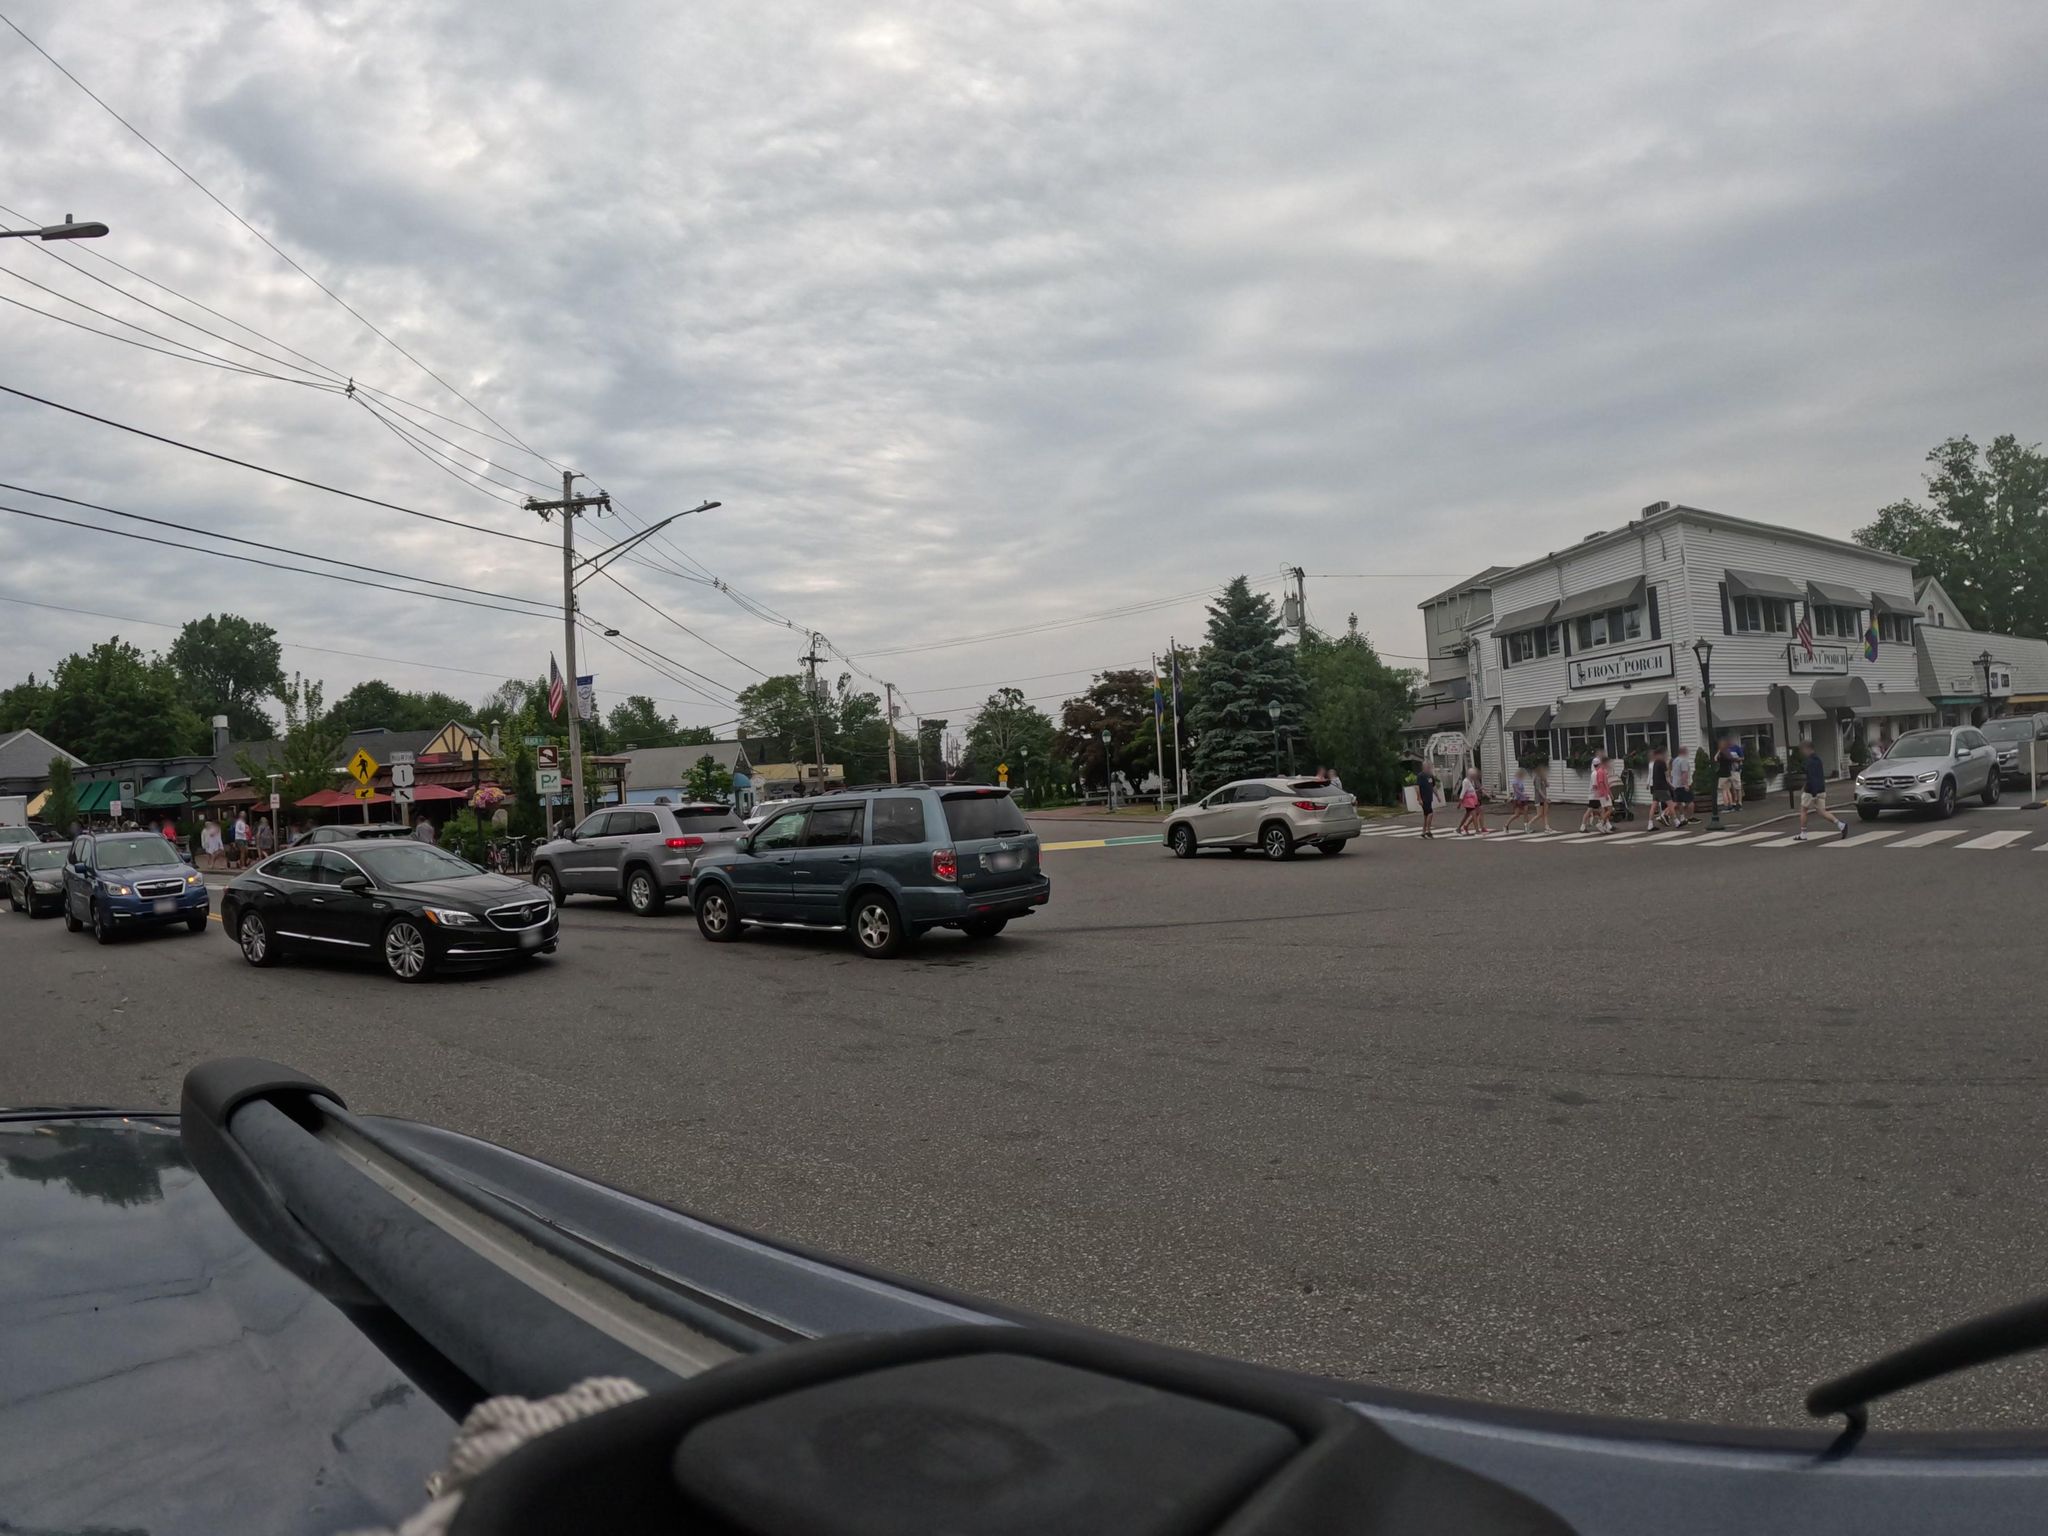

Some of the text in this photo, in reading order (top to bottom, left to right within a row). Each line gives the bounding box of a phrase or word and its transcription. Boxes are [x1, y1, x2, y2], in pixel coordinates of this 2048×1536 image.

[1824, 654, 1846, 665] PORCH
[1588, 662, 1621, 679] FRONT
[1624, 656, 1663, 674] PORCH
[401, 770, 405, 782] 1
